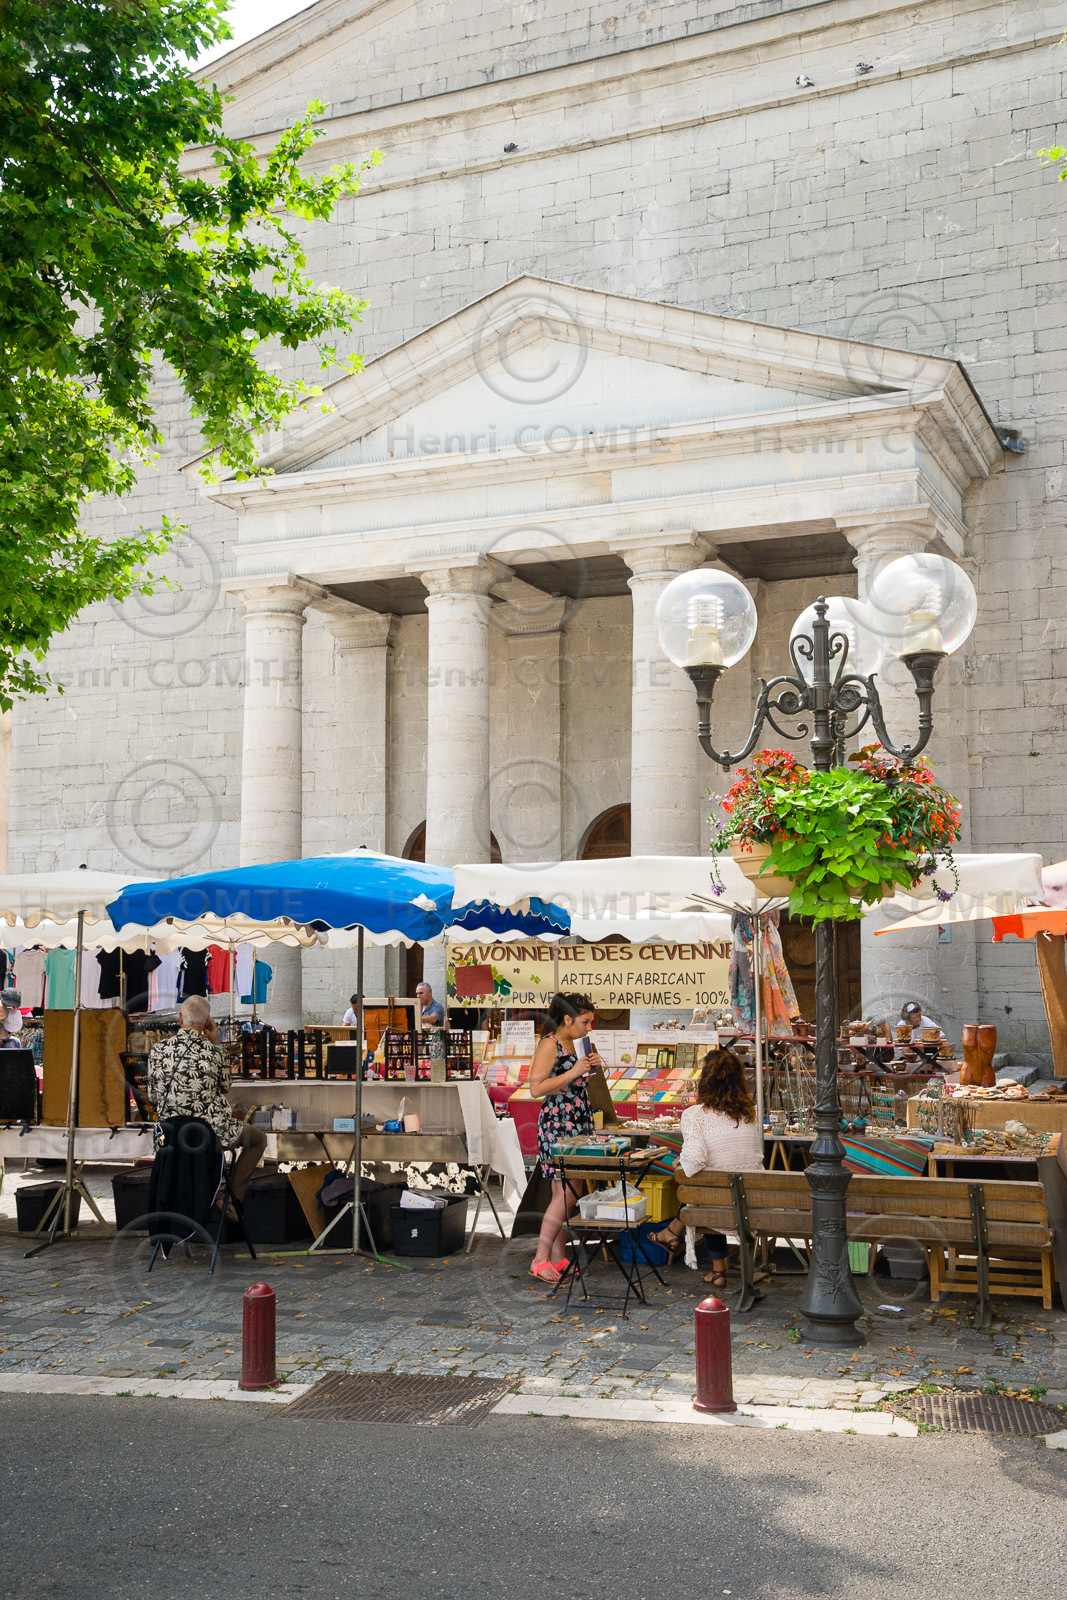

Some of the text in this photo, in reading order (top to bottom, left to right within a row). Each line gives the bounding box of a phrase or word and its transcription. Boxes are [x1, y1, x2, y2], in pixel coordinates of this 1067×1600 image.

[451, 945, 585, 961] SAVONNERIE
[591, 945, 633, 961] DES
[561, 972, 706, 986] ARTISAN FABRICANT
[512, 991, 536, 1004] PUR
[609, 991, 682, 1005] PARFUMES
[695, 990, 730, 1005] 100%
